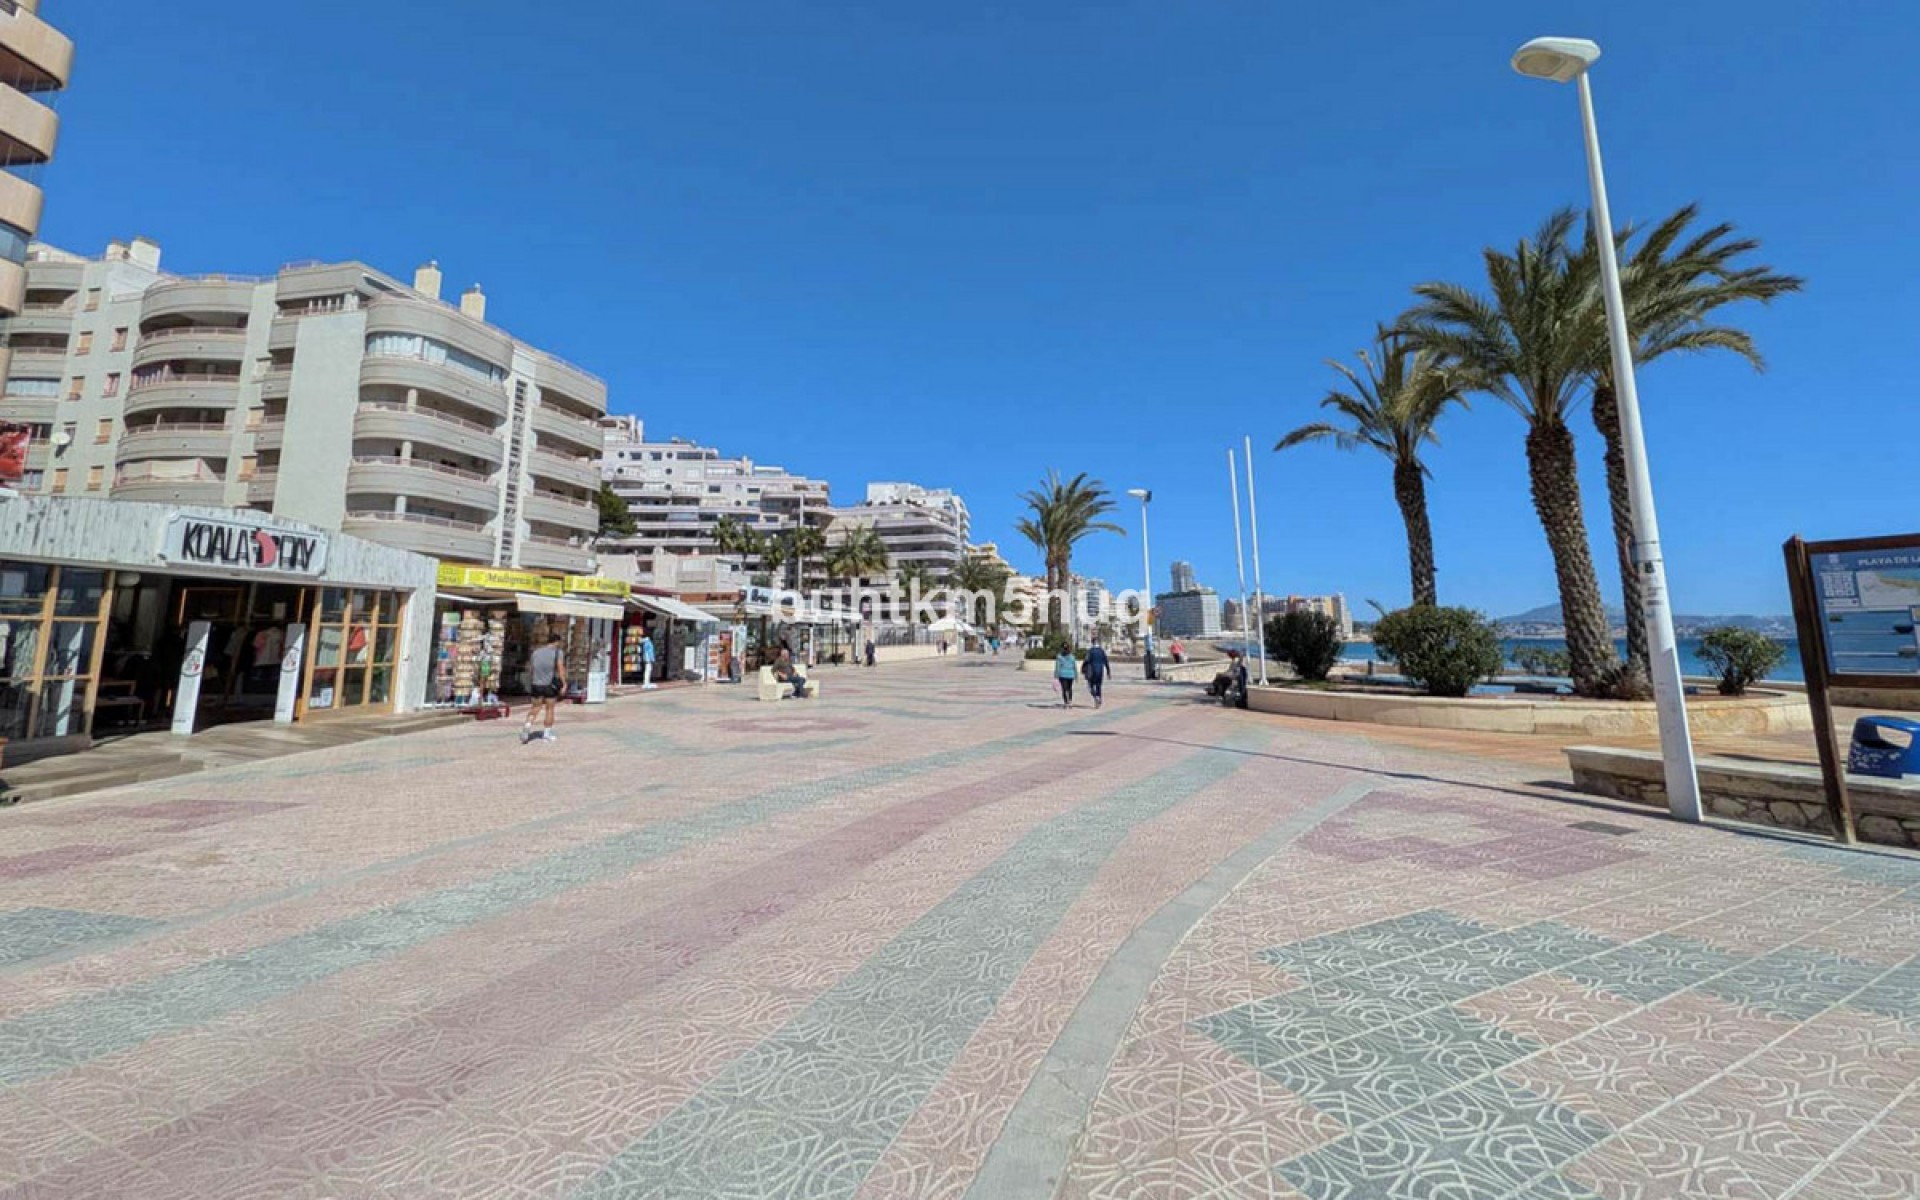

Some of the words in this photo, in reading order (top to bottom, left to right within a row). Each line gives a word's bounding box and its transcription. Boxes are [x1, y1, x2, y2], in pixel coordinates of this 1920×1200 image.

[181, 521, 250, 566] KOALA
[1858, 557, 1892, 566] PLAYA
[1893, 556, 1909, 564] DE
